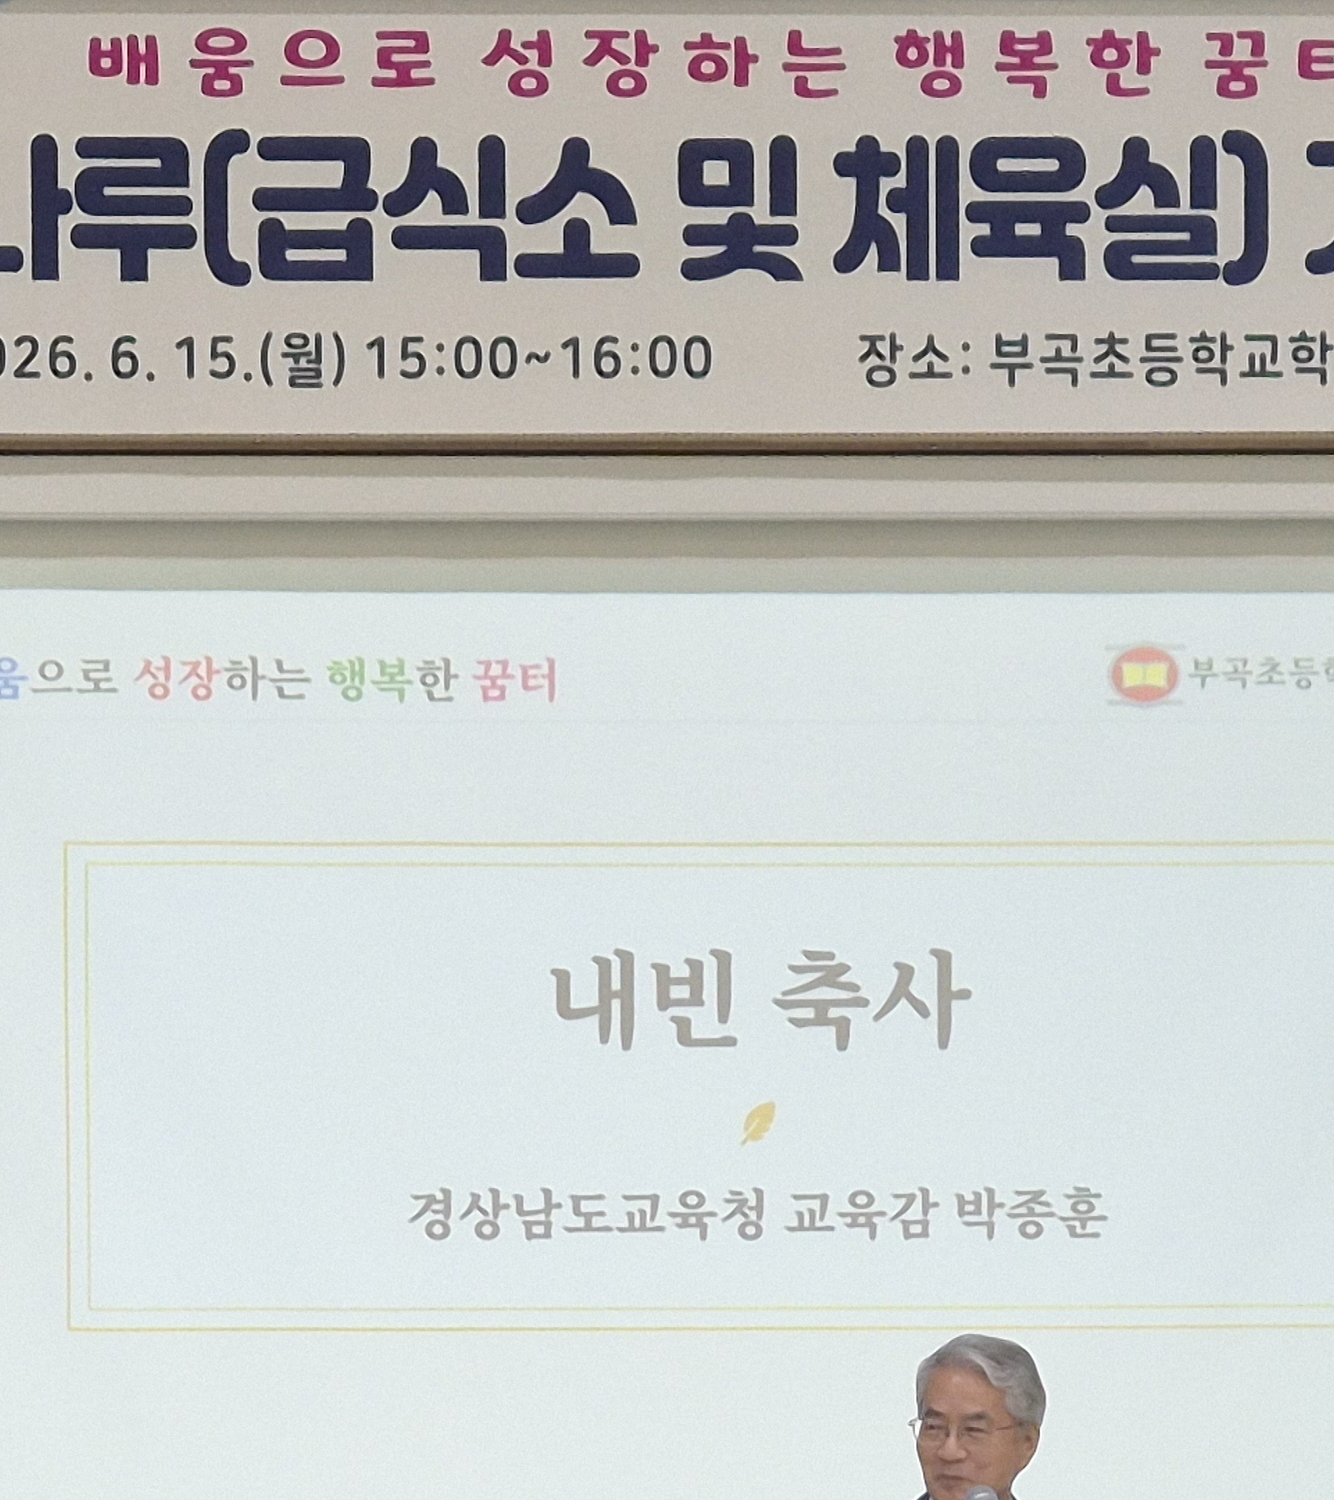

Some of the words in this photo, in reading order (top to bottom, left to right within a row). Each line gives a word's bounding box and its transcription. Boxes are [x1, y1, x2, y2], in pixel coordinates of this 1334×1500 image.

[88, 27, 435, 98] 배움으로
[481, 28, 846, 98] 성장하는
[894, 29, 1161, 99] 행복한
[677, 135, 803, 282] 및
[833, 130, 1269, 286] 체육실)
[111, 335, 155, 381] 6.
[175, 331, 345, 388] 15.(월)
[366, 335, 711, 379] 15:00~16:00
[859, 332, 970, 388] 장소:
[134, 655, 311, 701] 성장하는
[327, 657, 459, 703] 행복한
[472, 657, 556, 703] 꿈터
[550, 948, 738, 1051] 내빈
[772, 948, 972, 1052] 축사
[408, 1187, 764, 1241] 경상남도교육청
[784, 1187, 940, 1241] 교육감
[955, 1186, 1108, 1241] 박종훈
